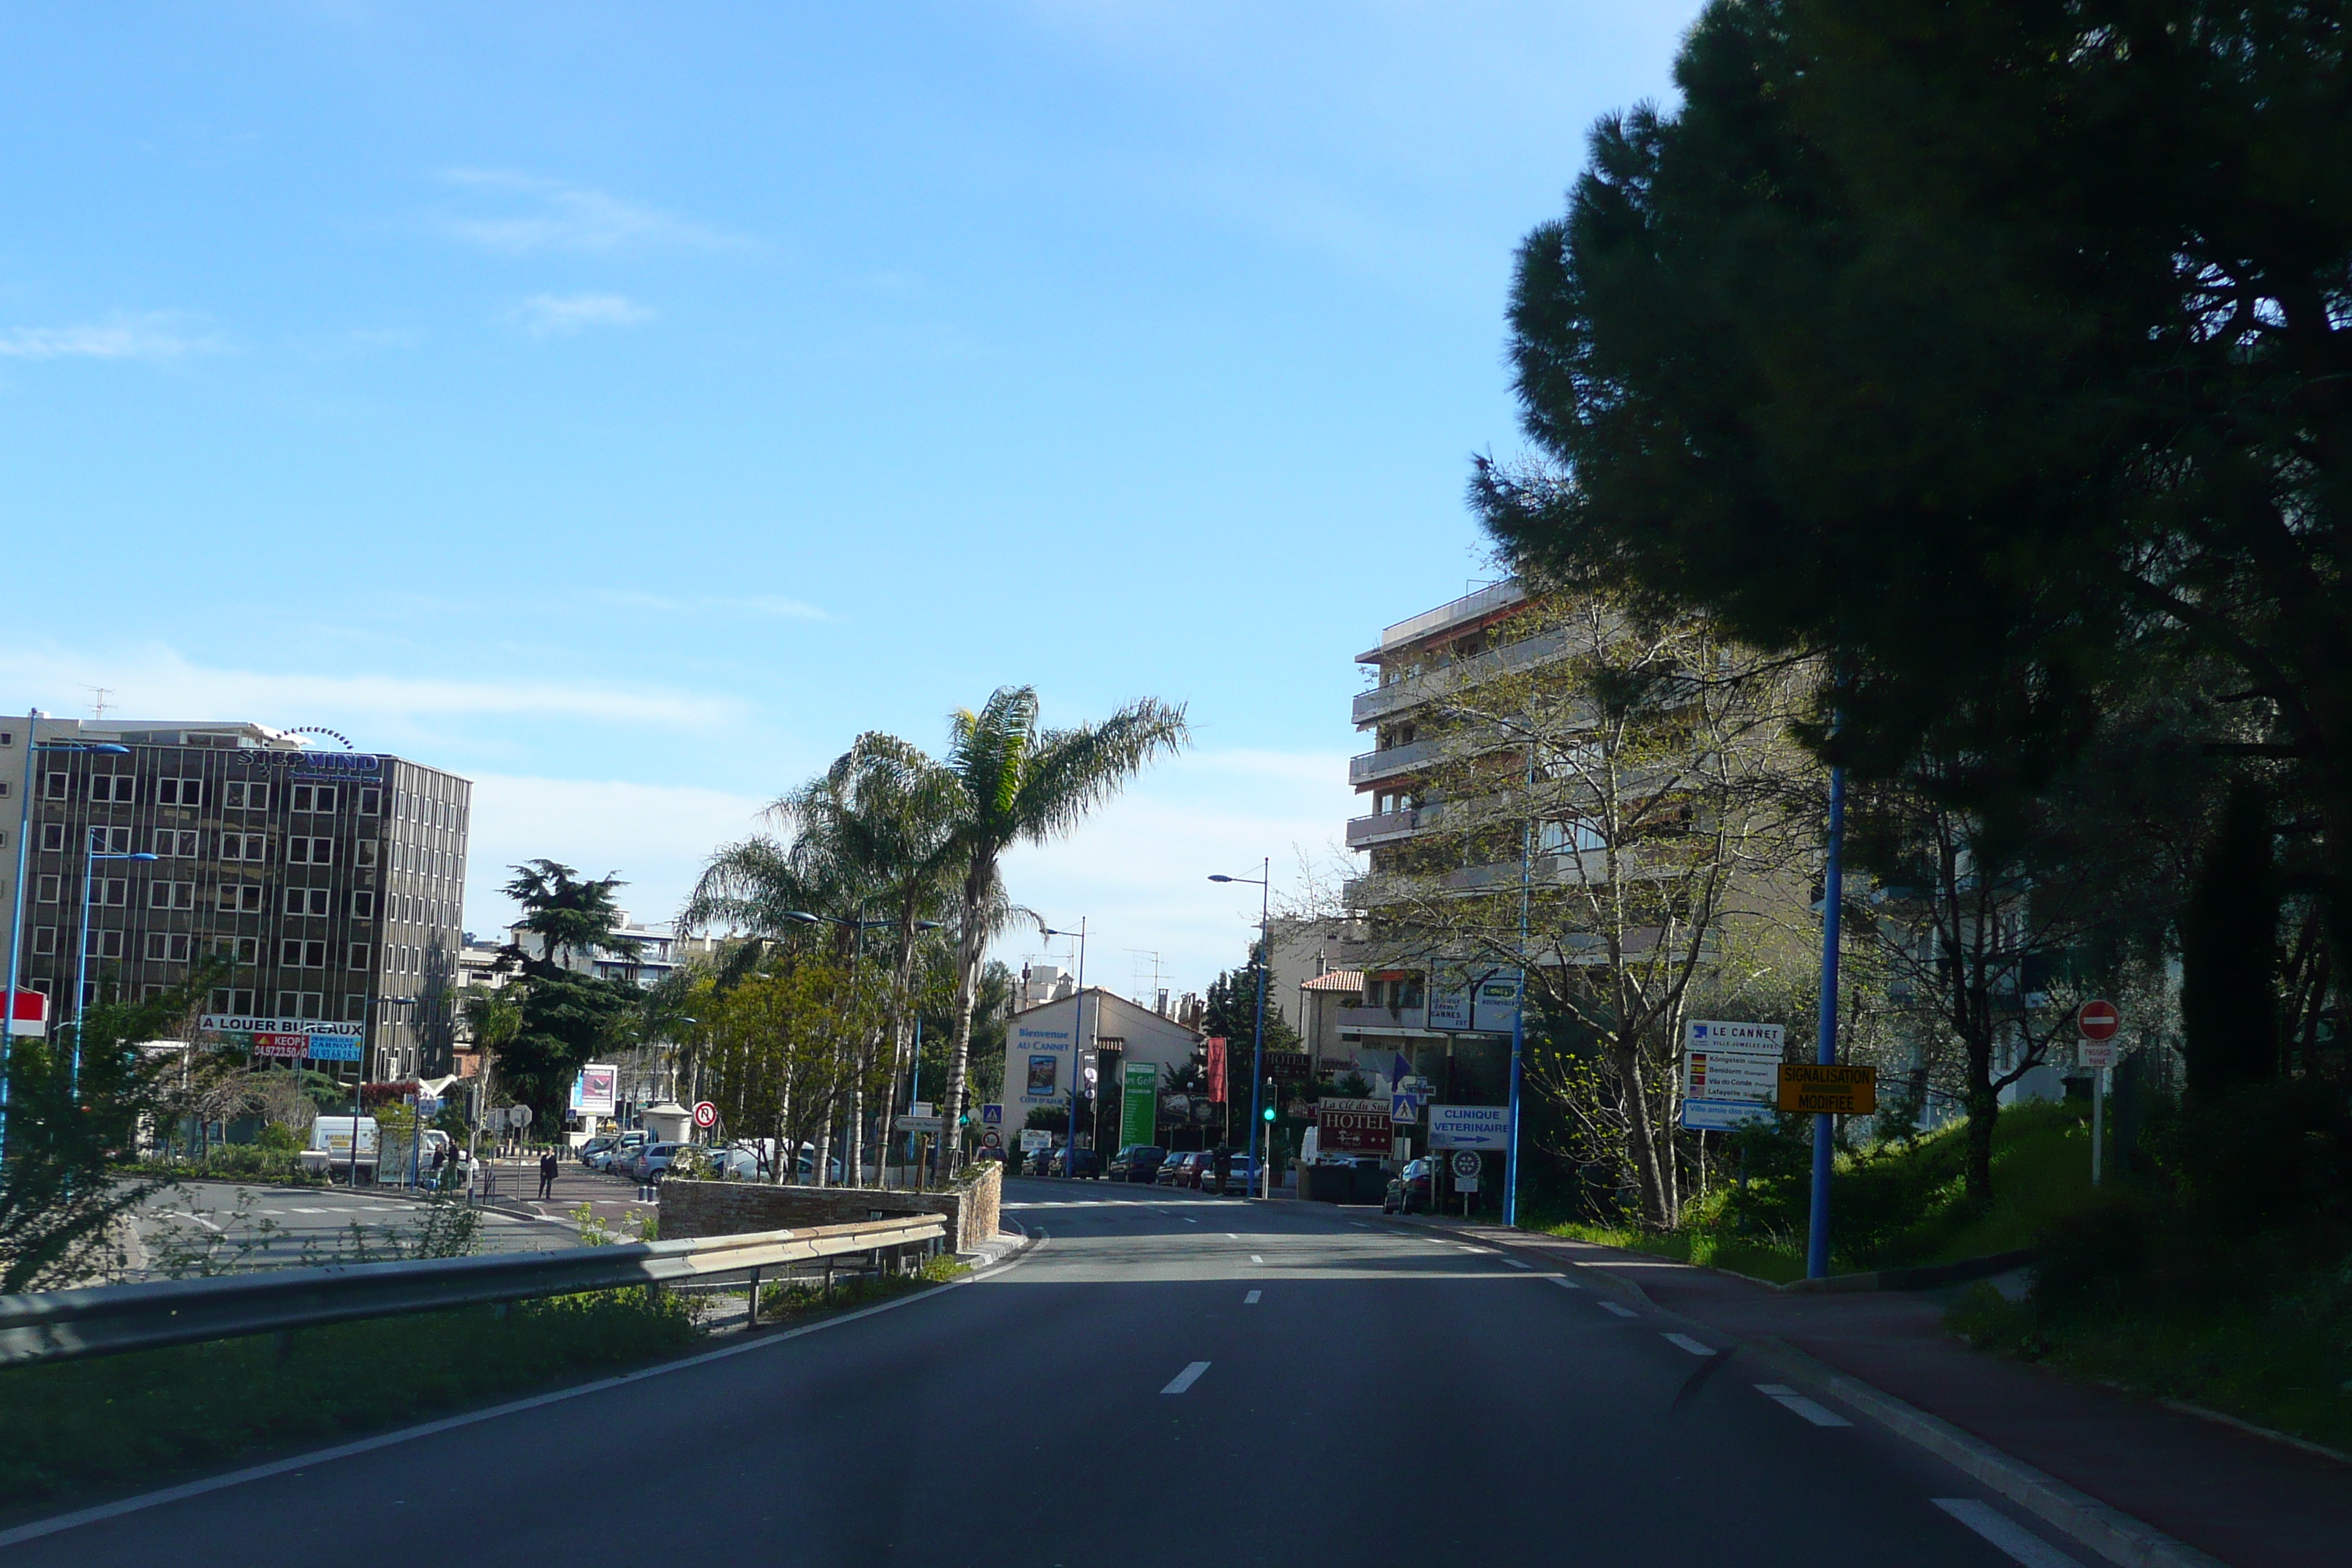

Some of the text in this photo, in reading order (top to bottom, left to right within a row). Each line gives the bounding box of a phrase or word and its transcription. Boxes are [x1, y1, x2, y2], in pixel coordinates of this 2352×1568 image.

[1431, 1011, 1461, 1019] CANNES
[203, 1017, 363, 1036] A LOUER BUREAUX
[1019, 1028, 1069, 1038] Bienvenue
[1713, 1027, 1778, 1039] LE CANNET
[274, 1036, 306, 1047] KEOPS
[1017, 1041, 1070, 1051] AU CANNET
[1266, 1055, 1308, 1066] HOTEL
[1709, 1056, 1746, 1064] Königstein
[1137, 1075, 1156, 1085] Golf
[1784, 1067, 1869, 1083] SIGNALISATION
[1708, 1088, 1741, 1096] Lafayette
[1324, 1100, 1390, 1111] La Clé du Sud
[1798, 1094, 1855, 1110] MODIFIEE
[1444, 1109, 1500, 1120] CLINIQUE
[1326, 1114, 1388, 1130] HOTEL
[1434, 1123, 1509, 1133] VETERINAIRE
